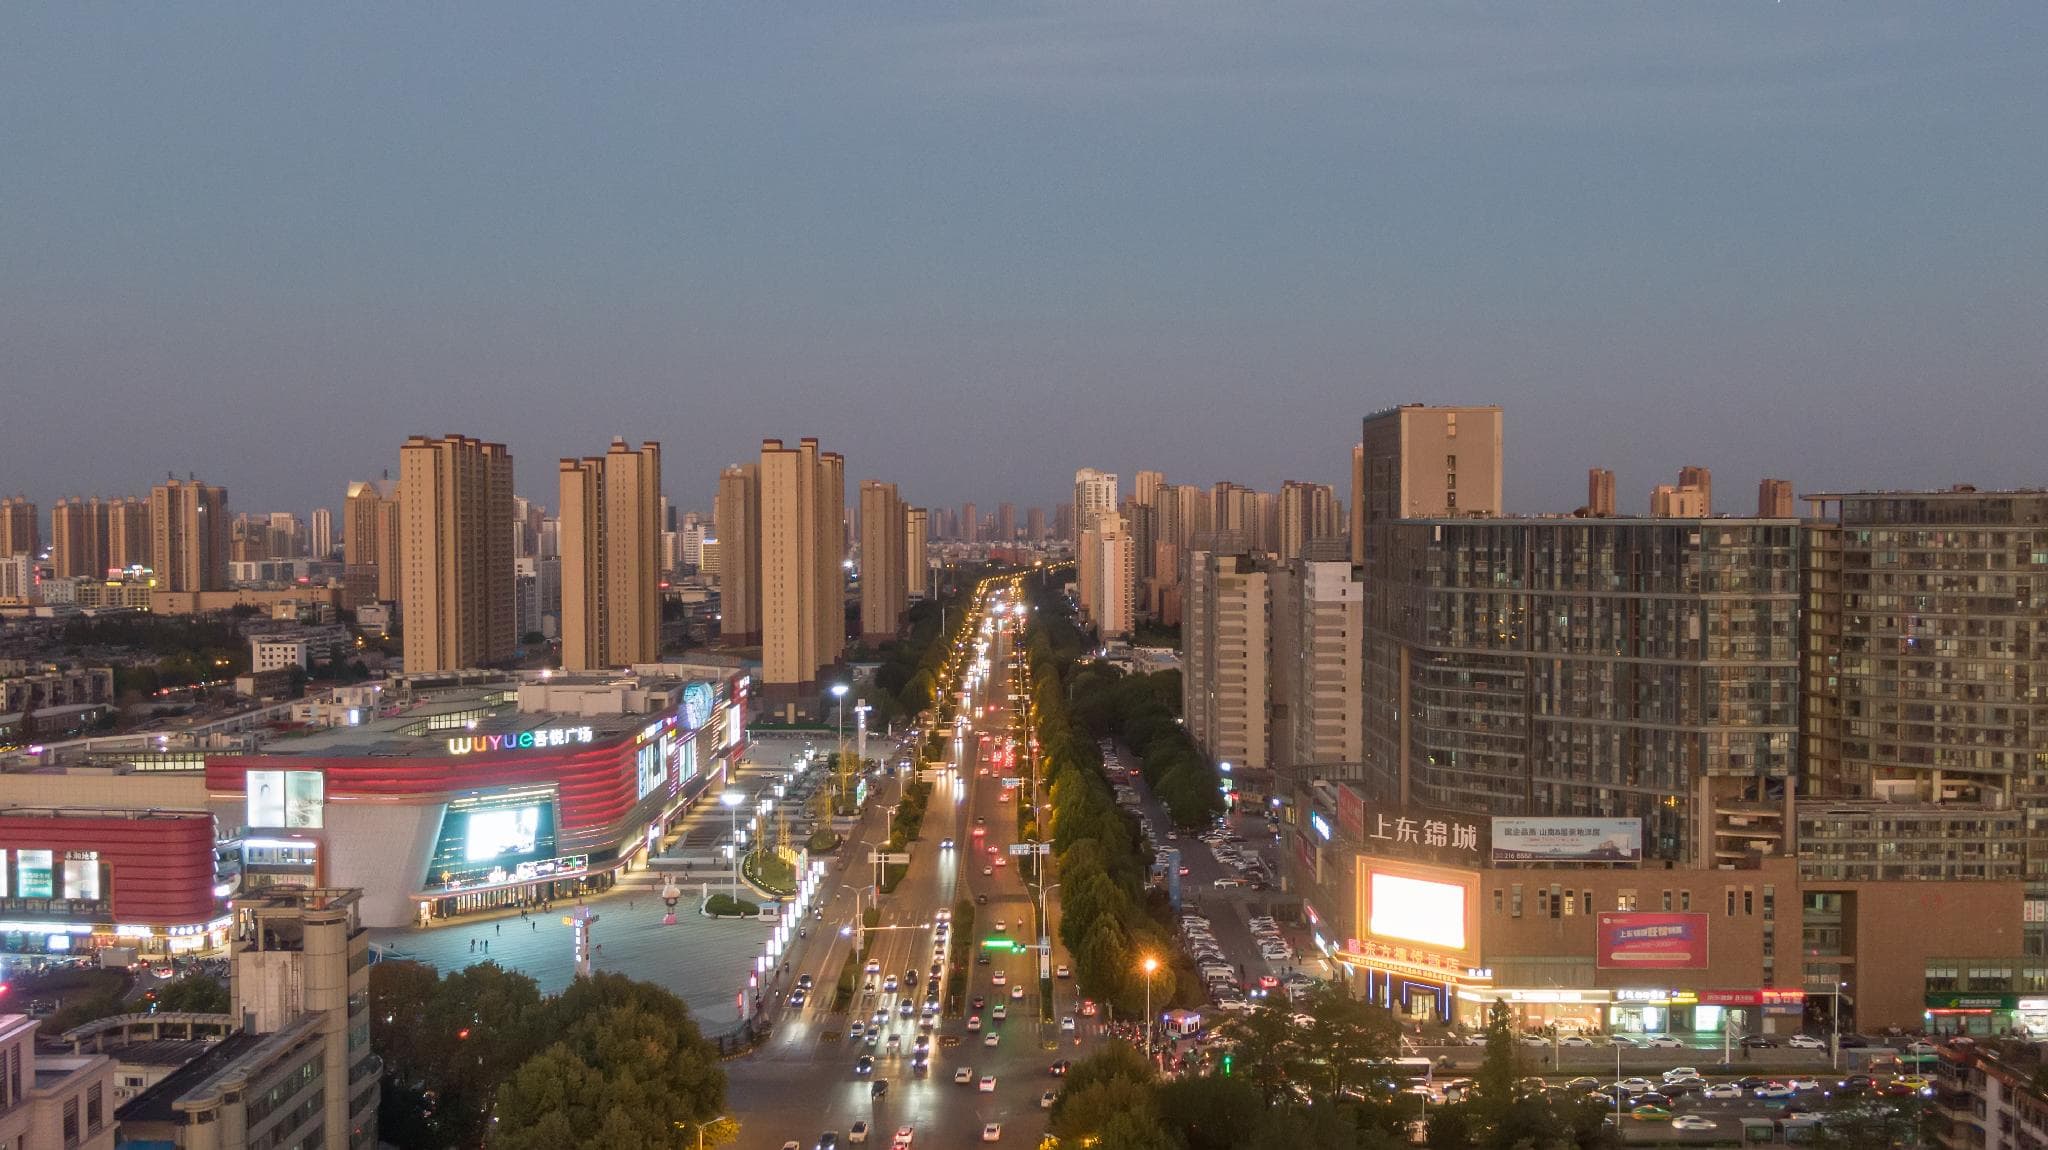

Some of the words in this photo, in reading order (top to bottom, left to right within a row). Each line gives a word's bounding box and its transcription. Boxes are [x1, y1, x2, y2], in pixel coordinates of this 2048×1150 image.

[534, 726, 593, 748] 吾悦广场
[1369, 813, 1478, 852] 上东锦城
